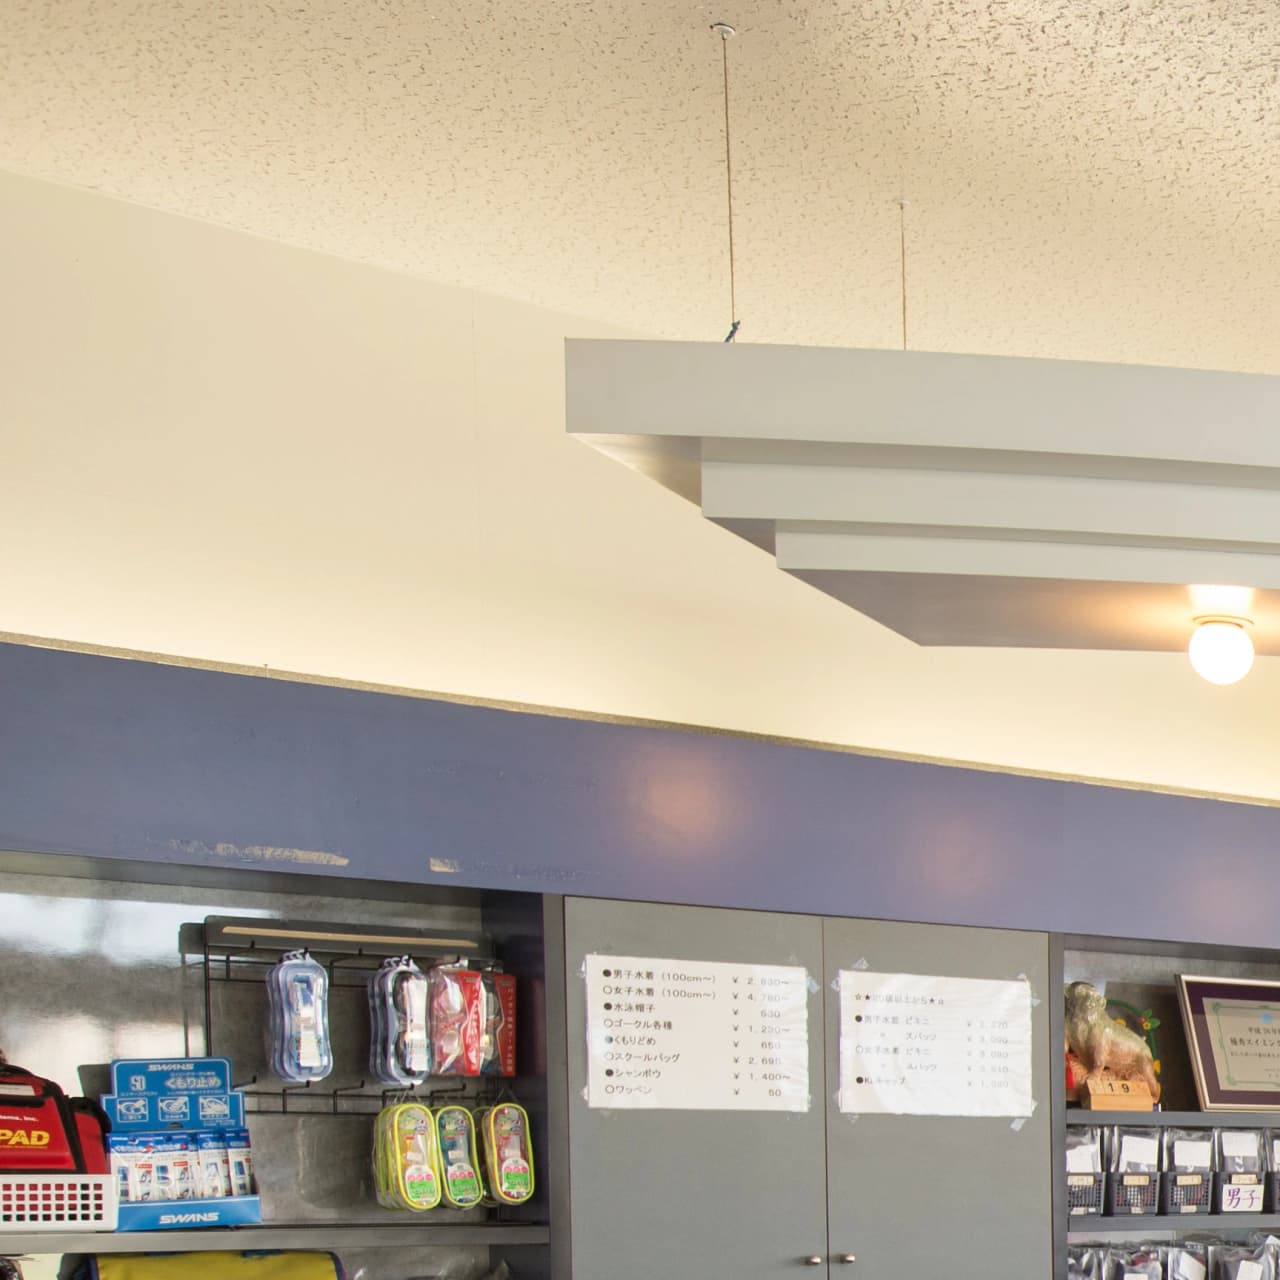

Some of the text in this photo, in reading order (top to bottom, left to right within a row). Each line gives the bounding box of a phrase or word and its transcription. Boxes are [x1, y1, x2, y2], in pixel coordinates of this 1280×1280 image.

[613, 969, 654, 980] 男子水着
[613, 987, 654, 997] 女子水着
[614, 1003, 655, 1013] 水泳帽子
[614, 1036, 656, 1046] くもりどめ
[148, 1063, 194, 1071] SWANS
[0, 1130, 50, 1145] PAD
[1227, 1188, 1261, 1208] 男子
[159, 1212, 220, 1224] SWANS
